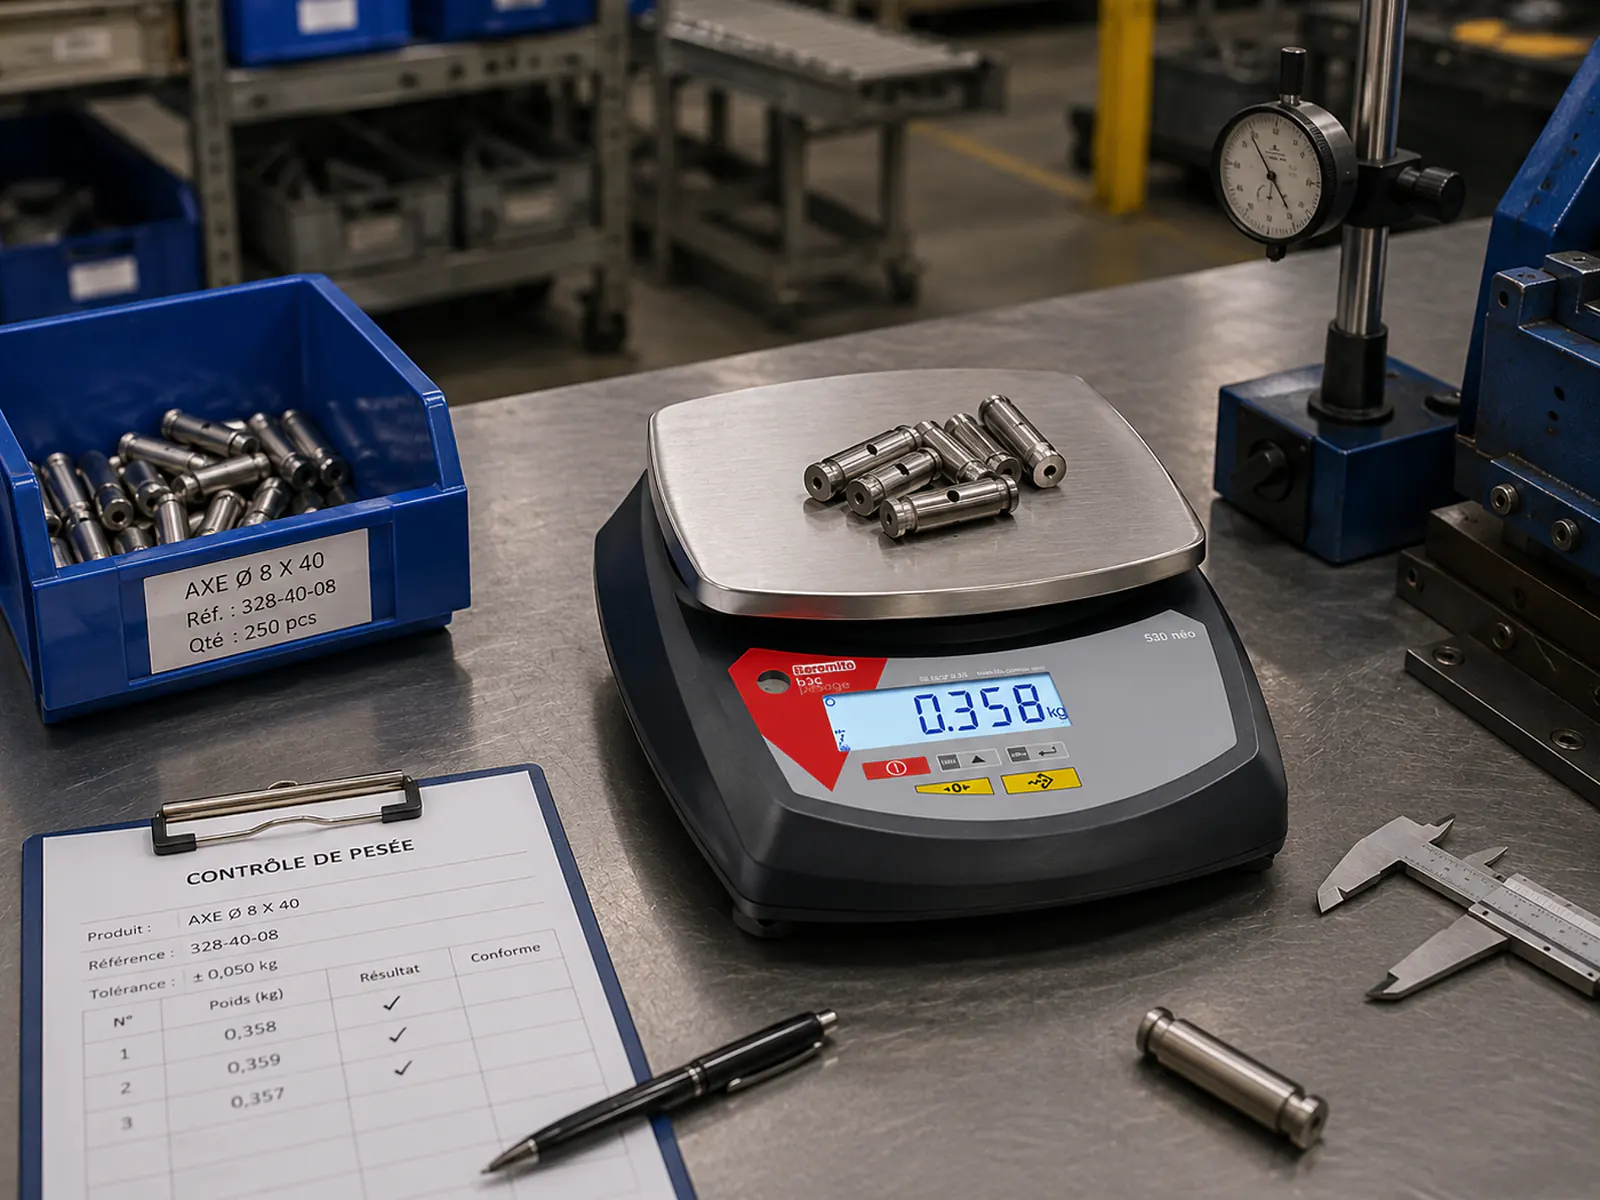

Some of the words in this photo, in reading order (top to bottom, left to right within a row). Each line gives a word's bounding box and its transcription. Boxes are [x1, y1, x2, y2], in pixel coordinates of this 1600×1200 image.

[184, 574, 229, 600] AXE
[259, 564, 272, 582] 8
[279, 558, 293, 577] X
[299, 551, 325, 571] 40
[186, 605, 223, 628] Réf.
[242, 578, 337, 615] 328-40-08
[189, 633, 224, 654] Qté
[244, 619, 280, 641] 250
[286, 612, 318, 634] pcs
[914, 683, 1046, 735] 0.358
[1046, 706, 1069, 720] kg
[186, 856, 307, 885] CONTRÔLE
[313, 852, 343, 866] DE
[349, 838, 415, 860] PESÉE
[87, 924, 144, 942] Produit
[188, 911, 223, 926] AXE
[247, 904, 257, 917] 8
[262, 902, 274, 914] X
[279, 898, 300, 911] 40
[88, 952, 166, 971] Référence
[190, 929, 279, 955] 328-40-08
[471, 942, 541, 963] Conforme
[90, 981, 167, 1000] Tolérance
[207, 962, 255, 981] 0,050
[259, 959, 278, 972] kg
[360, 964, 420, 983] Résultat
[209, 996, 251, 1010] Poids
[255, 988, 284, 1004] (kg)
[224, 1021, 277, 1041] 0,358
[120, 1048, 130, 1060] 1
[227, 1053, 281, 1075] 0,359
[120, 1082, 131, 1094] 2
[231, 1086, 285, 1109] 0,357
[121, 1116, 132, 1131] 3
